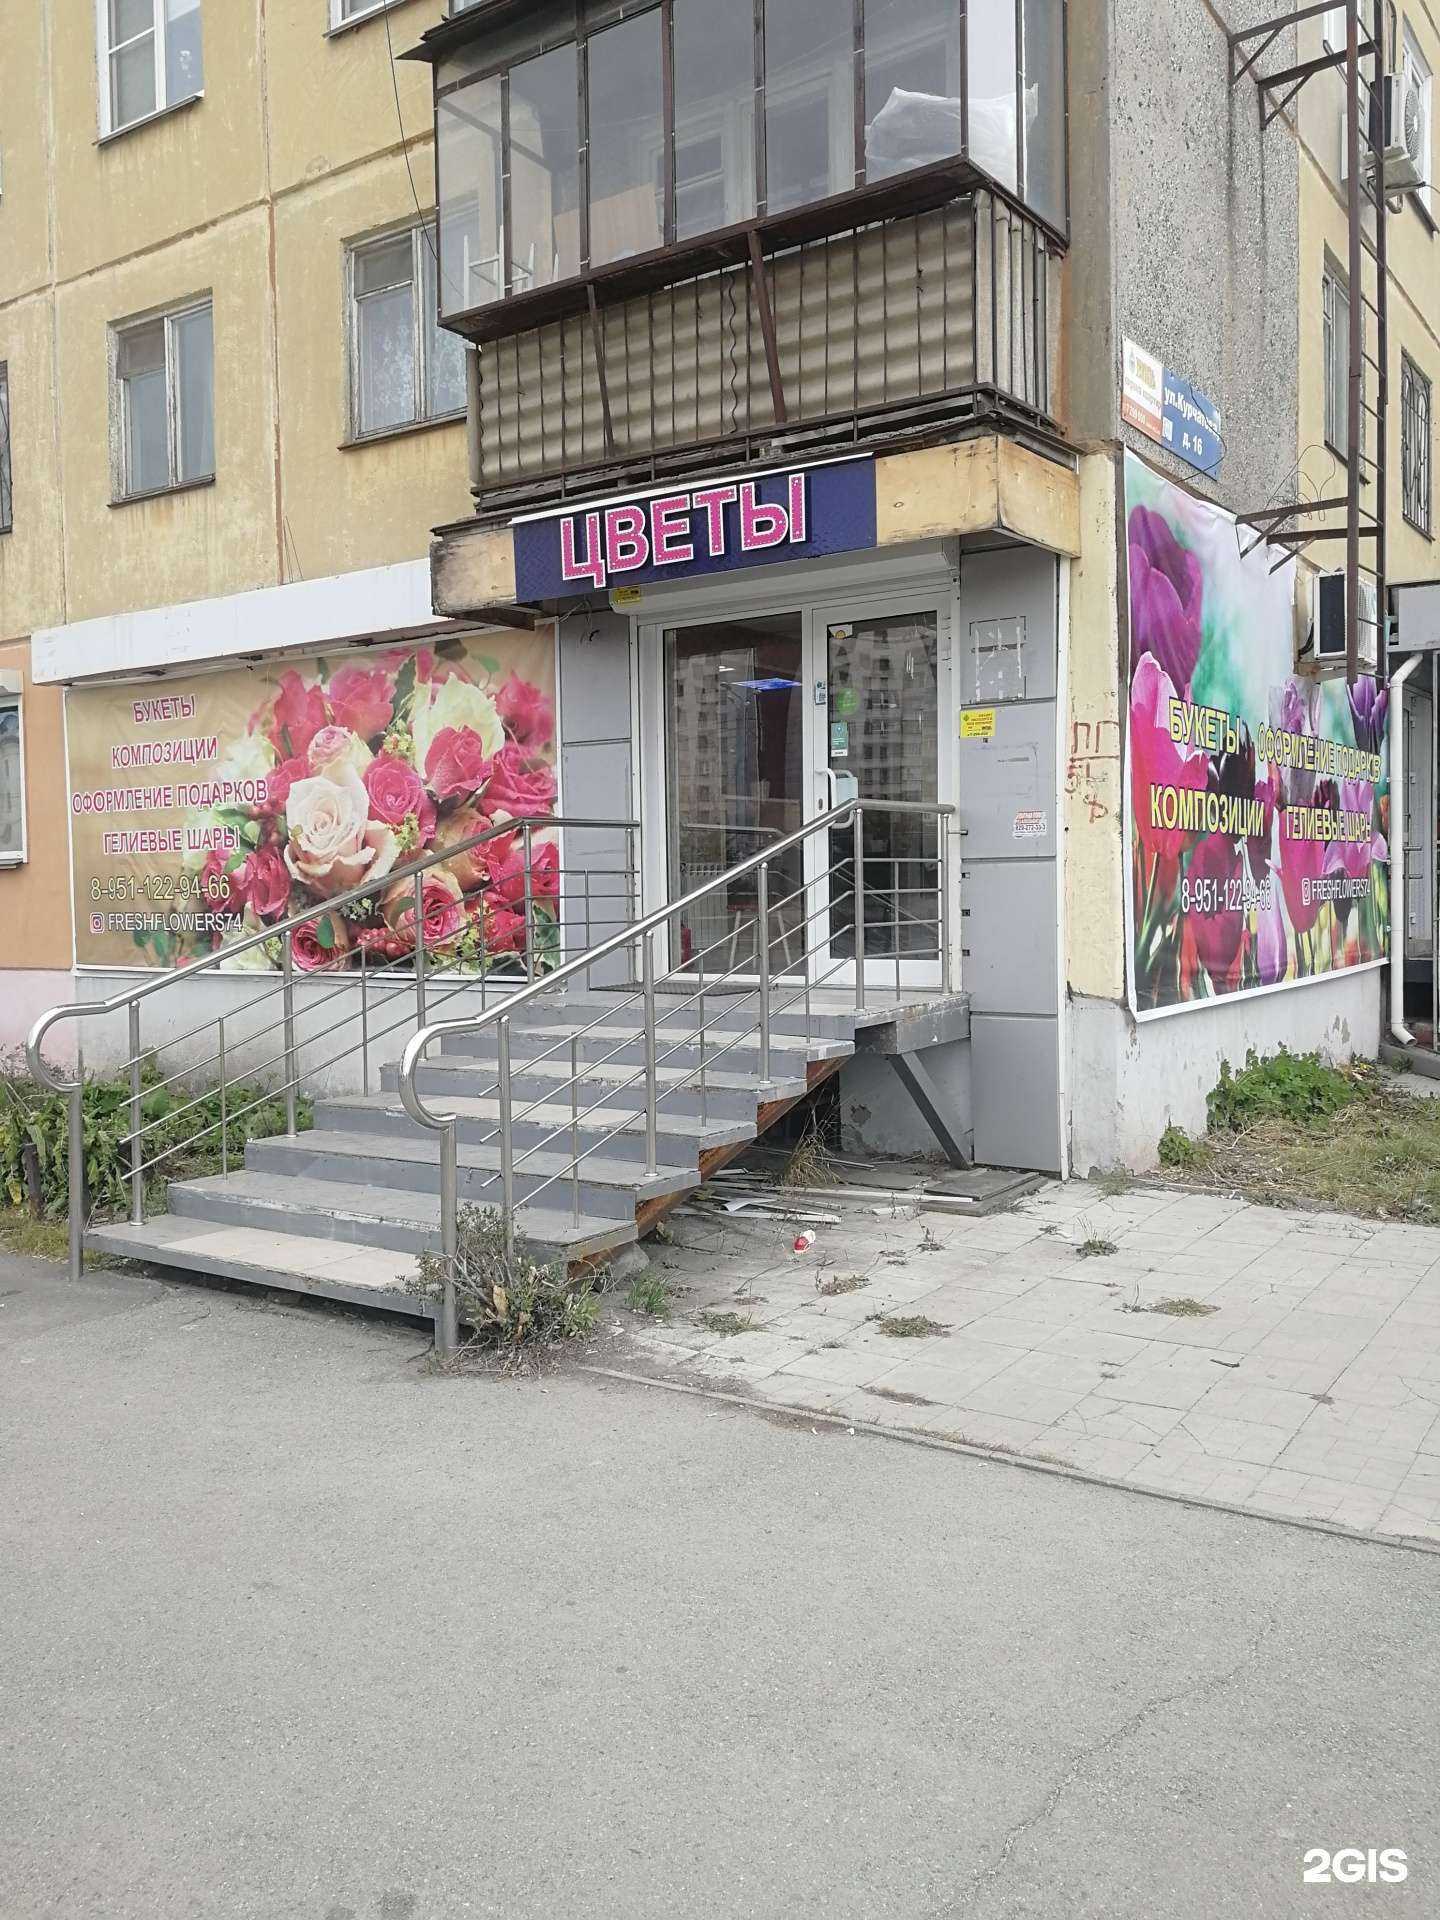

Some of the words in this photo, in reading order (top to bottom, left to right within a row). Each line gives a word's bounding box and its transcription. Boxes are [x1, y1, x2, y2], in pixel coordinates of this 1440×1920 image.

[1193, 435, 1203, 456] 16
[560, 472, 806, 589] ЦВЕТЫ
[133, 694, 196, 723] БУКЕТЫ
[1169, 696, 1241, 755] БУКЕТЫ
[112, 735, 218, 769] КОМПОЗИЦИИ
[1258, 721, 1335, 775] ОФОРМЛЕНИЕ
[72, 785, 173, 813] ОФОРМЛЕНИЕ
[176, 778, 268, 810] ПОДАРКОВ
[1150, 782, 1265, 838] КОМПОЗИЦИИ
[103, 829, 183, 854] ГЕЛИЕВЫЕ
[186, 824, 240, 850] ШАРЫ
[1286, 804, 1345, 842] ГЕЛИЕВЫЕ
[91, 874, 231, 901] 8-951-122-94-66
[1181, 877, 1272, 913] 8-951-122-94-66
[108, 911, 243, 932] FRESHFLOWERS74
